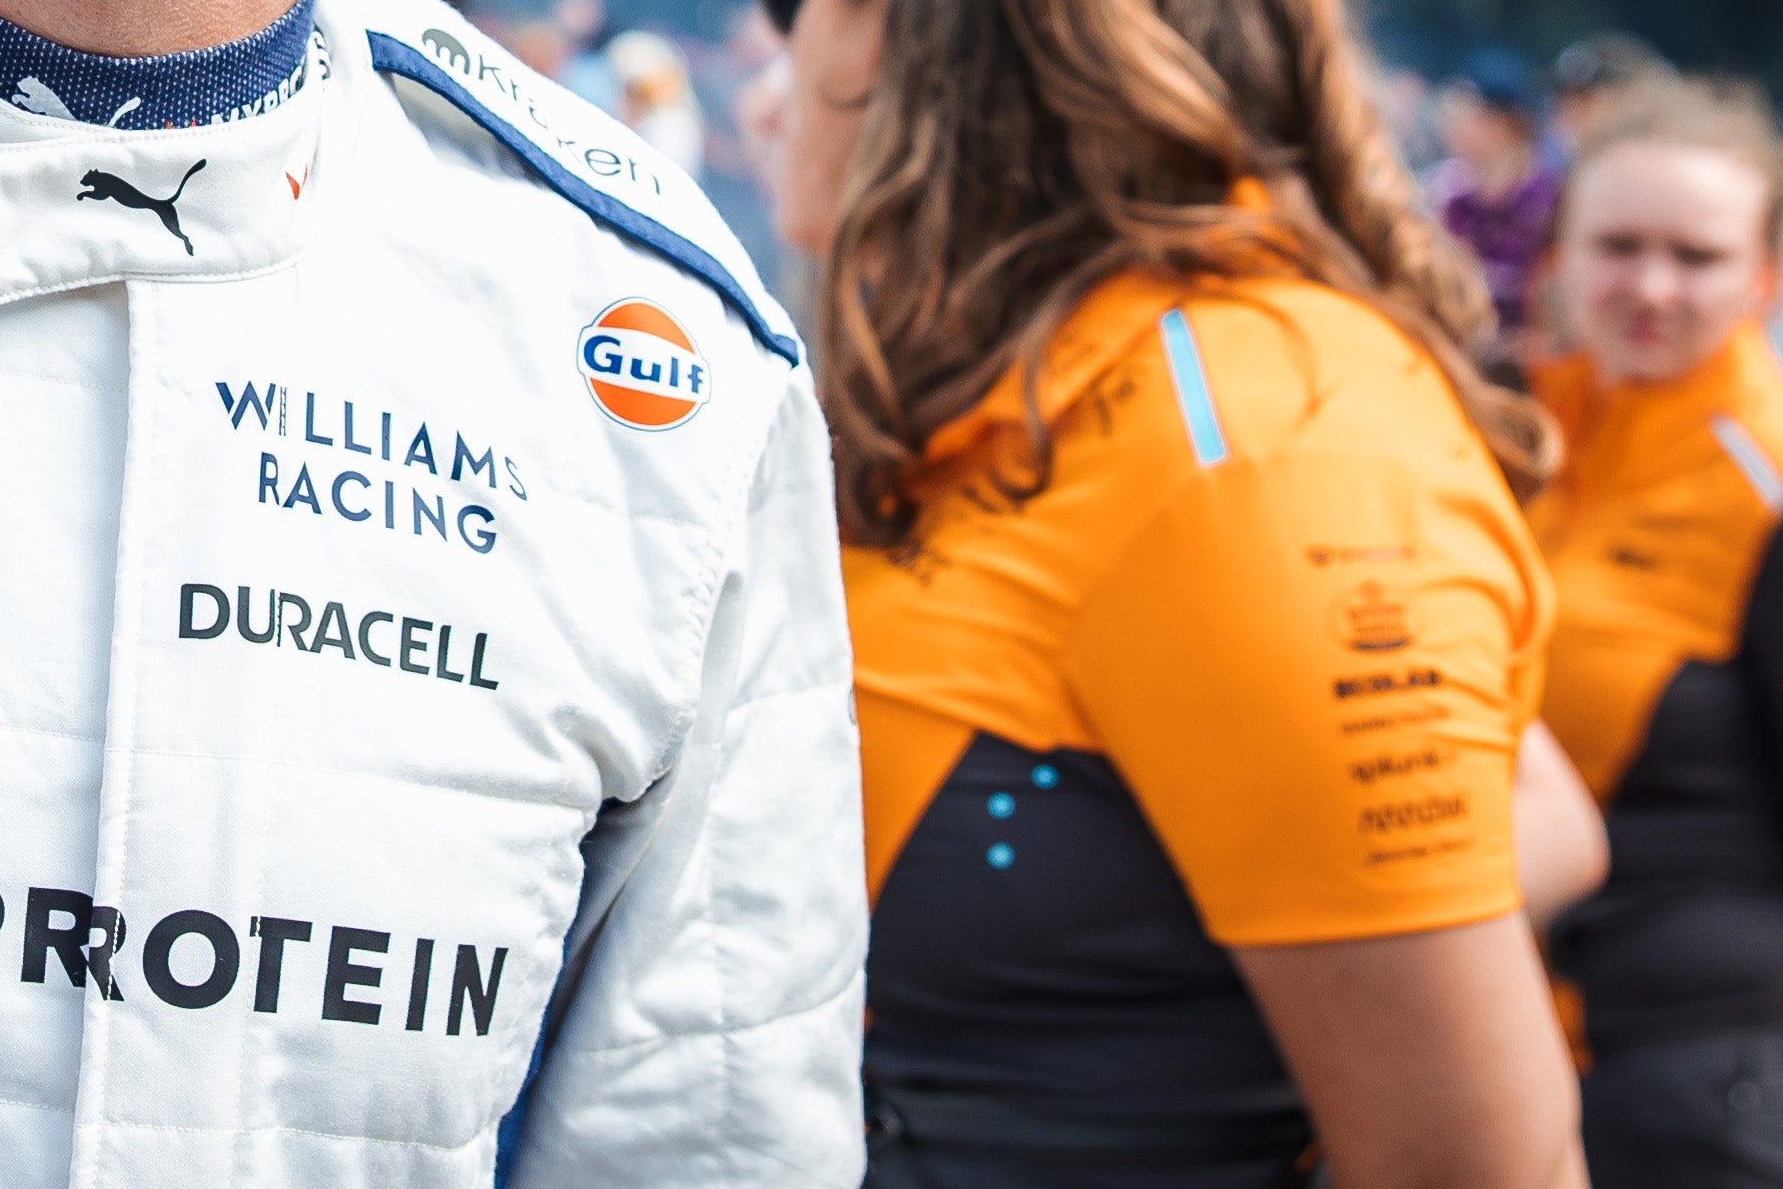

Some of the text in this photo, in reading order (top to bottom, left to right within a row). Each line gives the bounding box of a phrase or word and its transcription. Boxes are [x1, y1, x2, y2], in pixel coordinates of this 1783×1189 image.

[583, 334, 705, 395] Gulf
[215, 380, 528, 502] WILLIAMS
[258, 451, 498, 555] RACING
[178, 583, 500, 691] DURACELL
